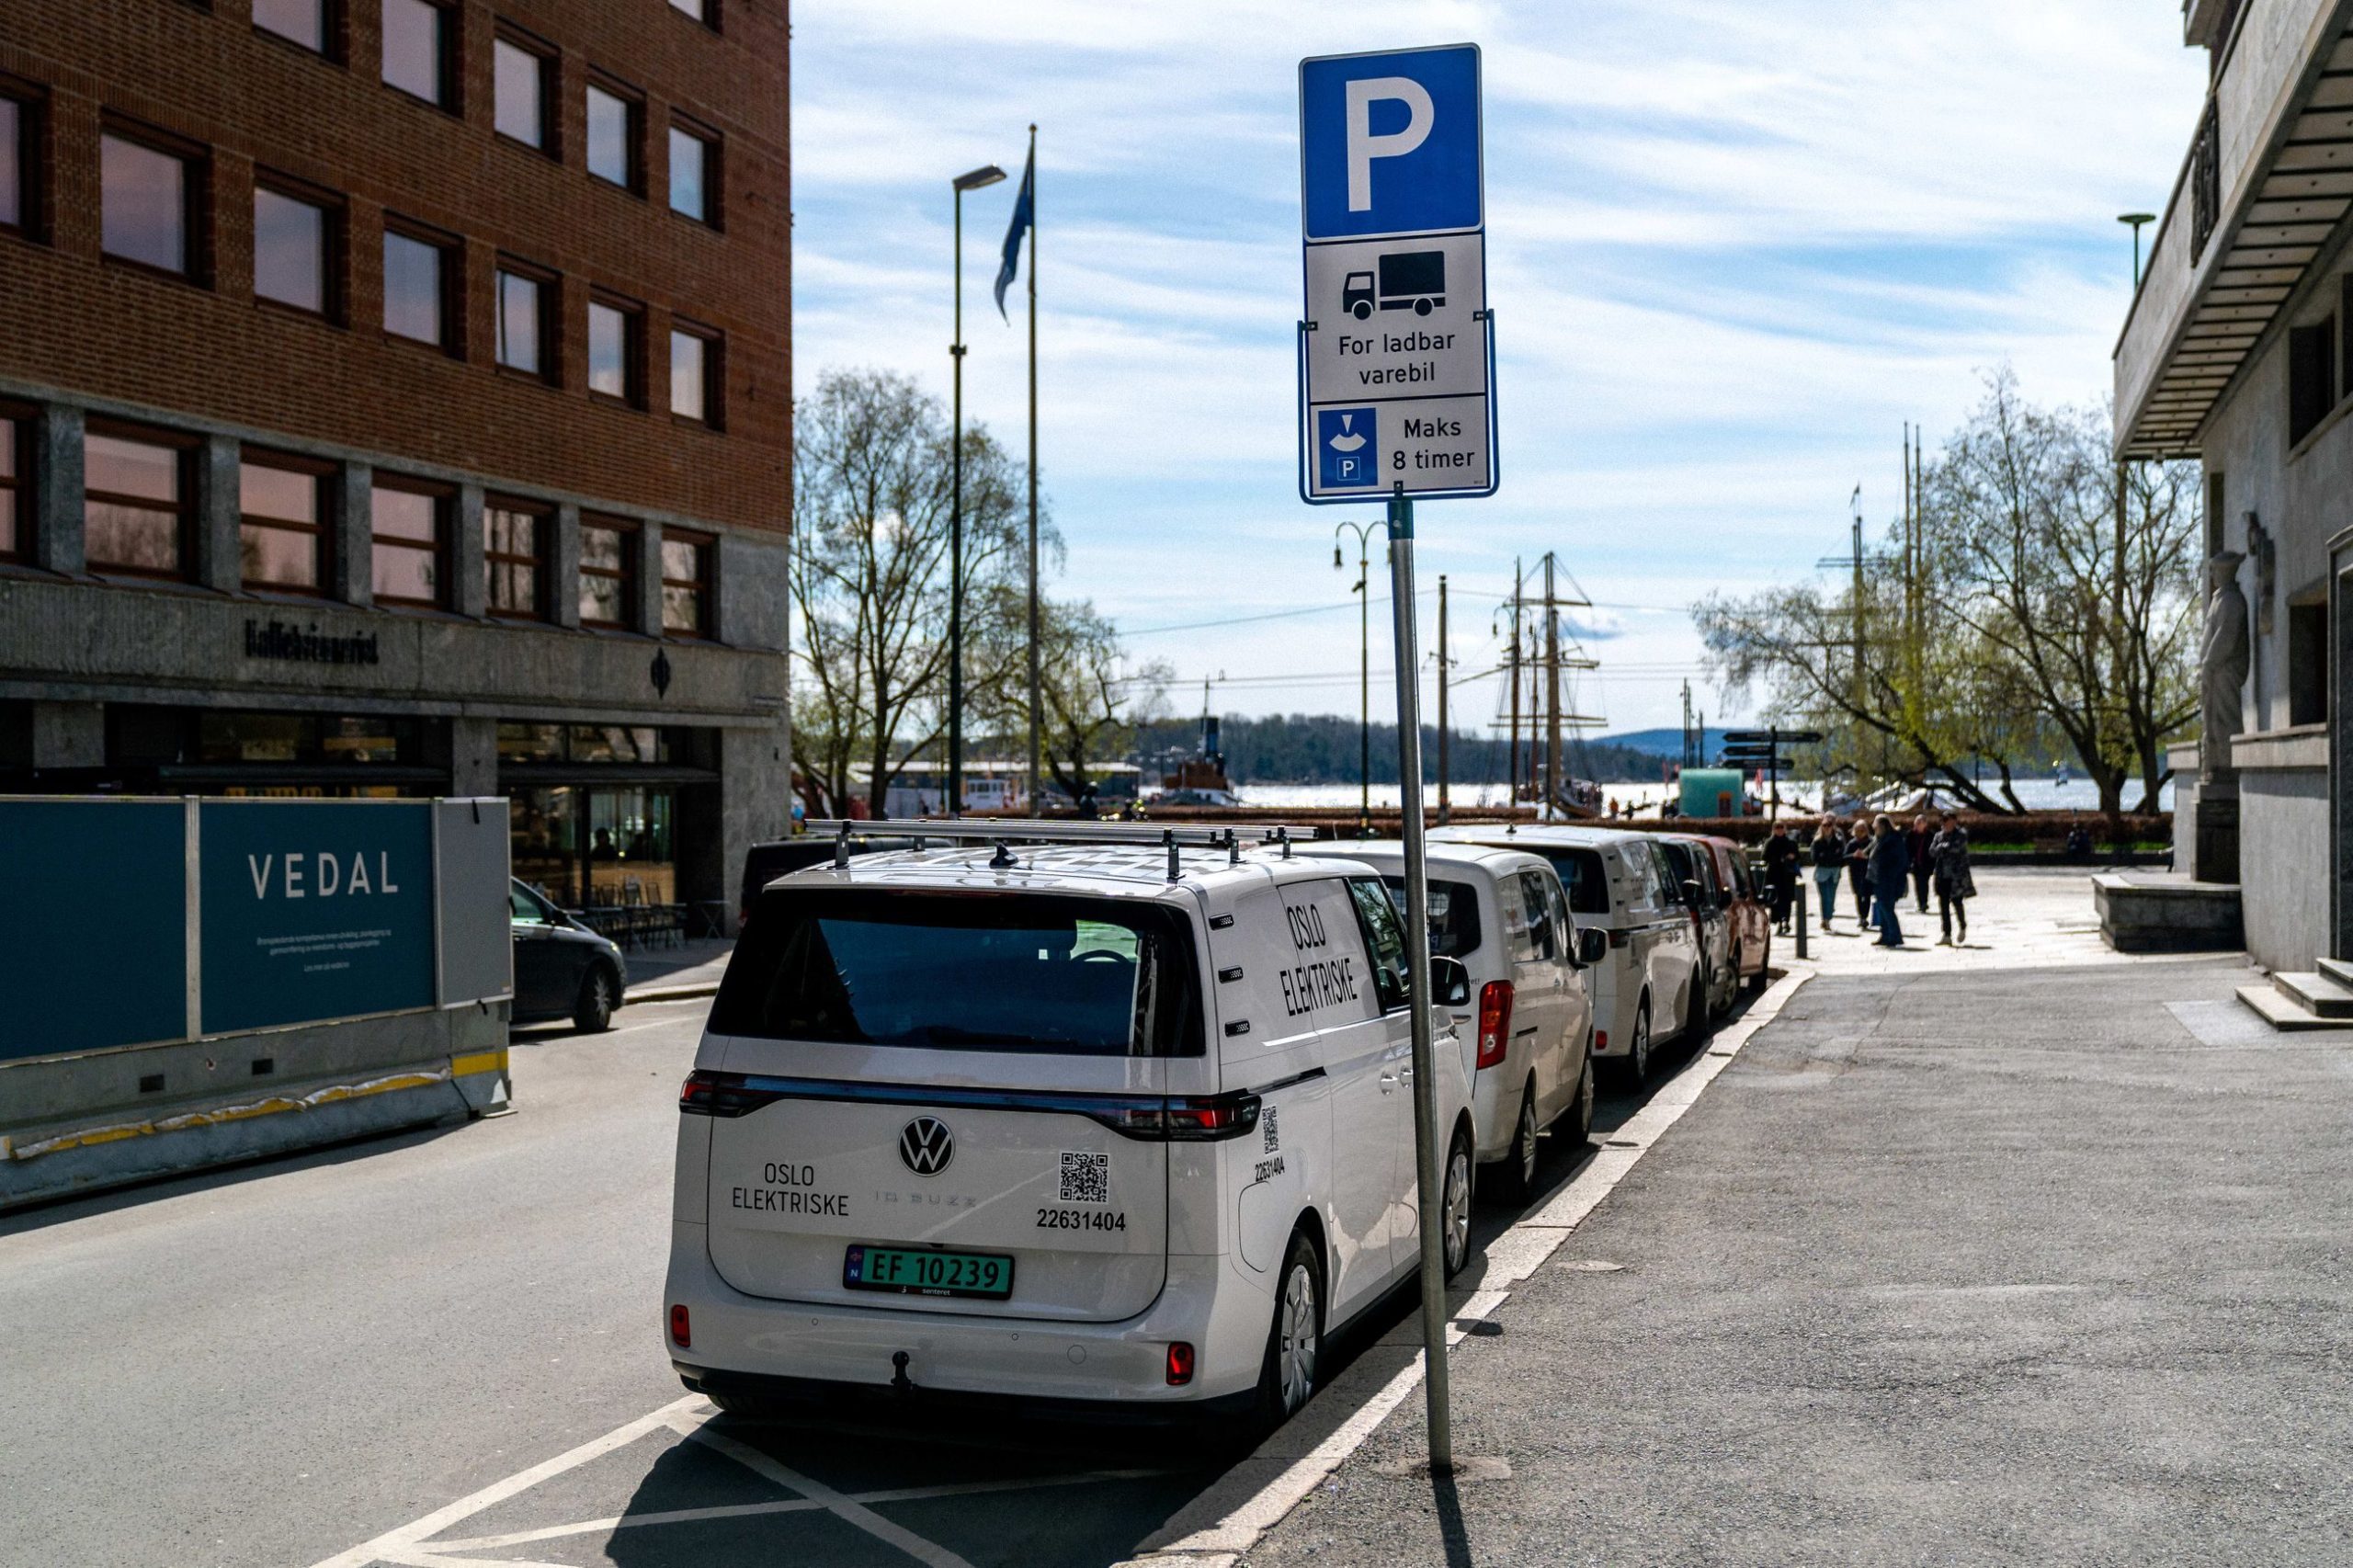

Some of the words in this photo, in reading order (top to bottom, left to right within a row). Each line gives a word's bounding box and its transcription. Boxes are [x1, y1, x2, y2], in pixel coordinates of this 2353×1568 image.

[1346, 76, 1435, 212] P
[1339, 335, 1374, 356] For
[1383, 331, 1456, 354] ladbar
[1358, 361, 1436, 385] varebil
[1404, 417, 1461, 438] Maks
[1342, 460, 1355, 478] P
[1392, 450, 1406, 471] 8
[1414, 449, 1475, 470] timer
[248, 851, 399, 900] VEDAL
[1286, 903, 1326, 951] OSLO
[1279, 957, 1358, 1017] ELEKTRISKE
[764, 1162, 814, 1187] OSLO
[1255, 1155, 1285, 1182] 22631404
[732, 1187, 849, 1217] ELEKTRISKE
[1036, 1208, 1126, 1232] 22631404
[850, 1268, 858, 1278] N
[872, 1254, 903, 1281] EF
[915, 1256, 1000, 1289] 10239
